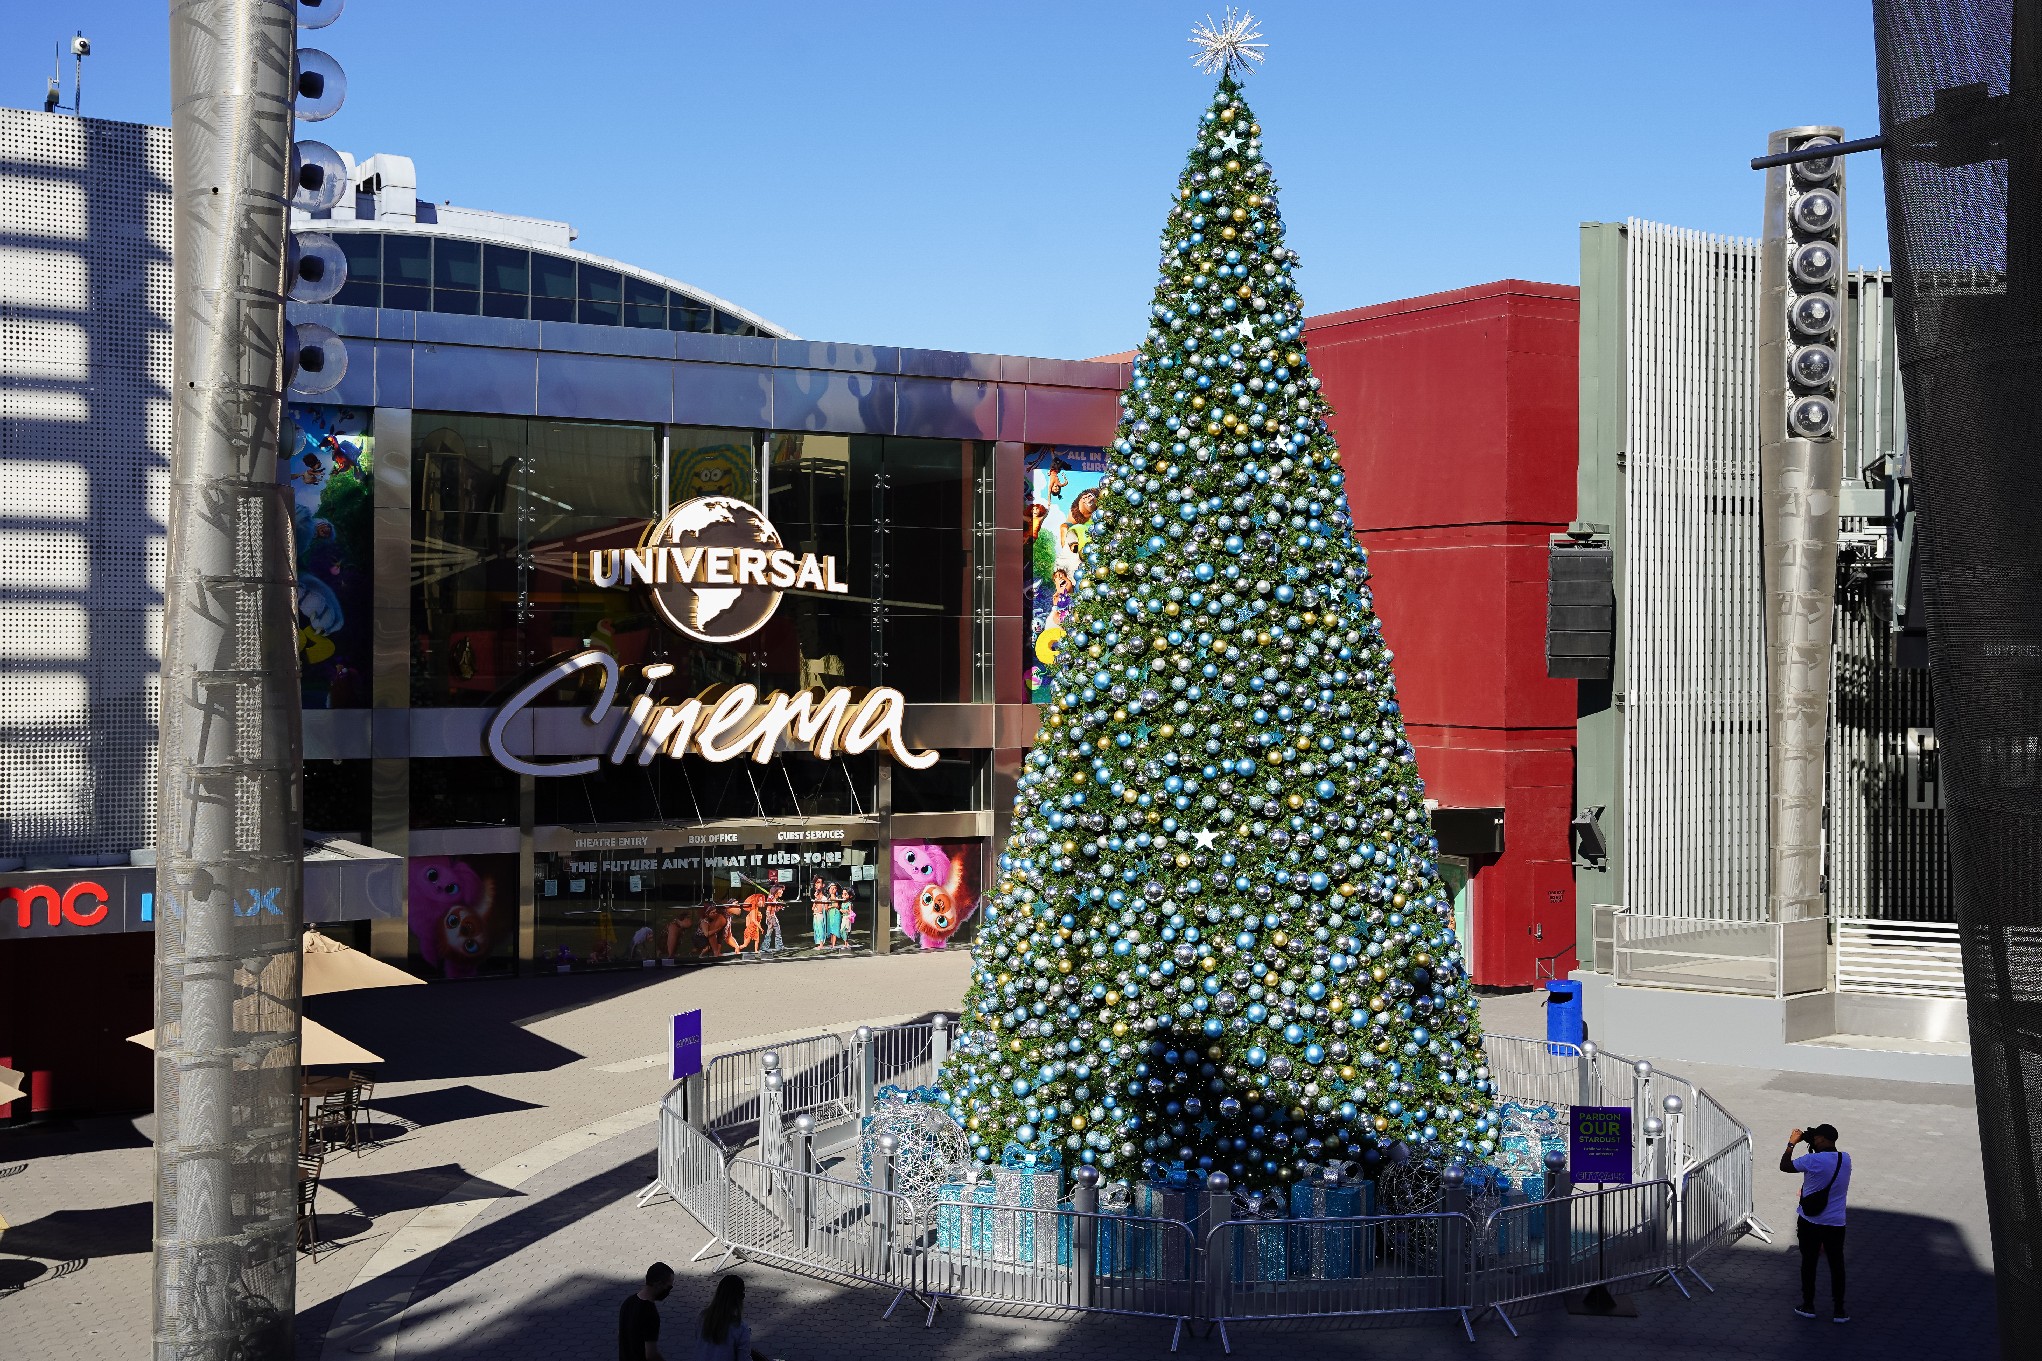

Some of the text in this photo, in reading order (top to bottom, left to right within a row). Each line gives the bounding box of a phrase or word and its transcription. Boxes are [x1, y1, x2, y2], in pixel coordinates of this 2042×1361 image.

[1067, 451, 1086, 461] ALL
[1090, 452, 1102, 461] IN
[591, 547, 849, 593] UNIVERSAL
[487, 650, 940, 778] Cinema
[688, 833, 738, 844] BOX OFFICE
[778, 830, 845, 840] GUEST SERVICES
[575, 836, 648, 848] THEATRE ENTRY
[570, 851, 842, 873] THE FUTURE AIN'T WHAT IT USED TO BE
[1579, 1113, 1621, 1121] PARDON
[1579, 1122, 1620, 1135] OUR
